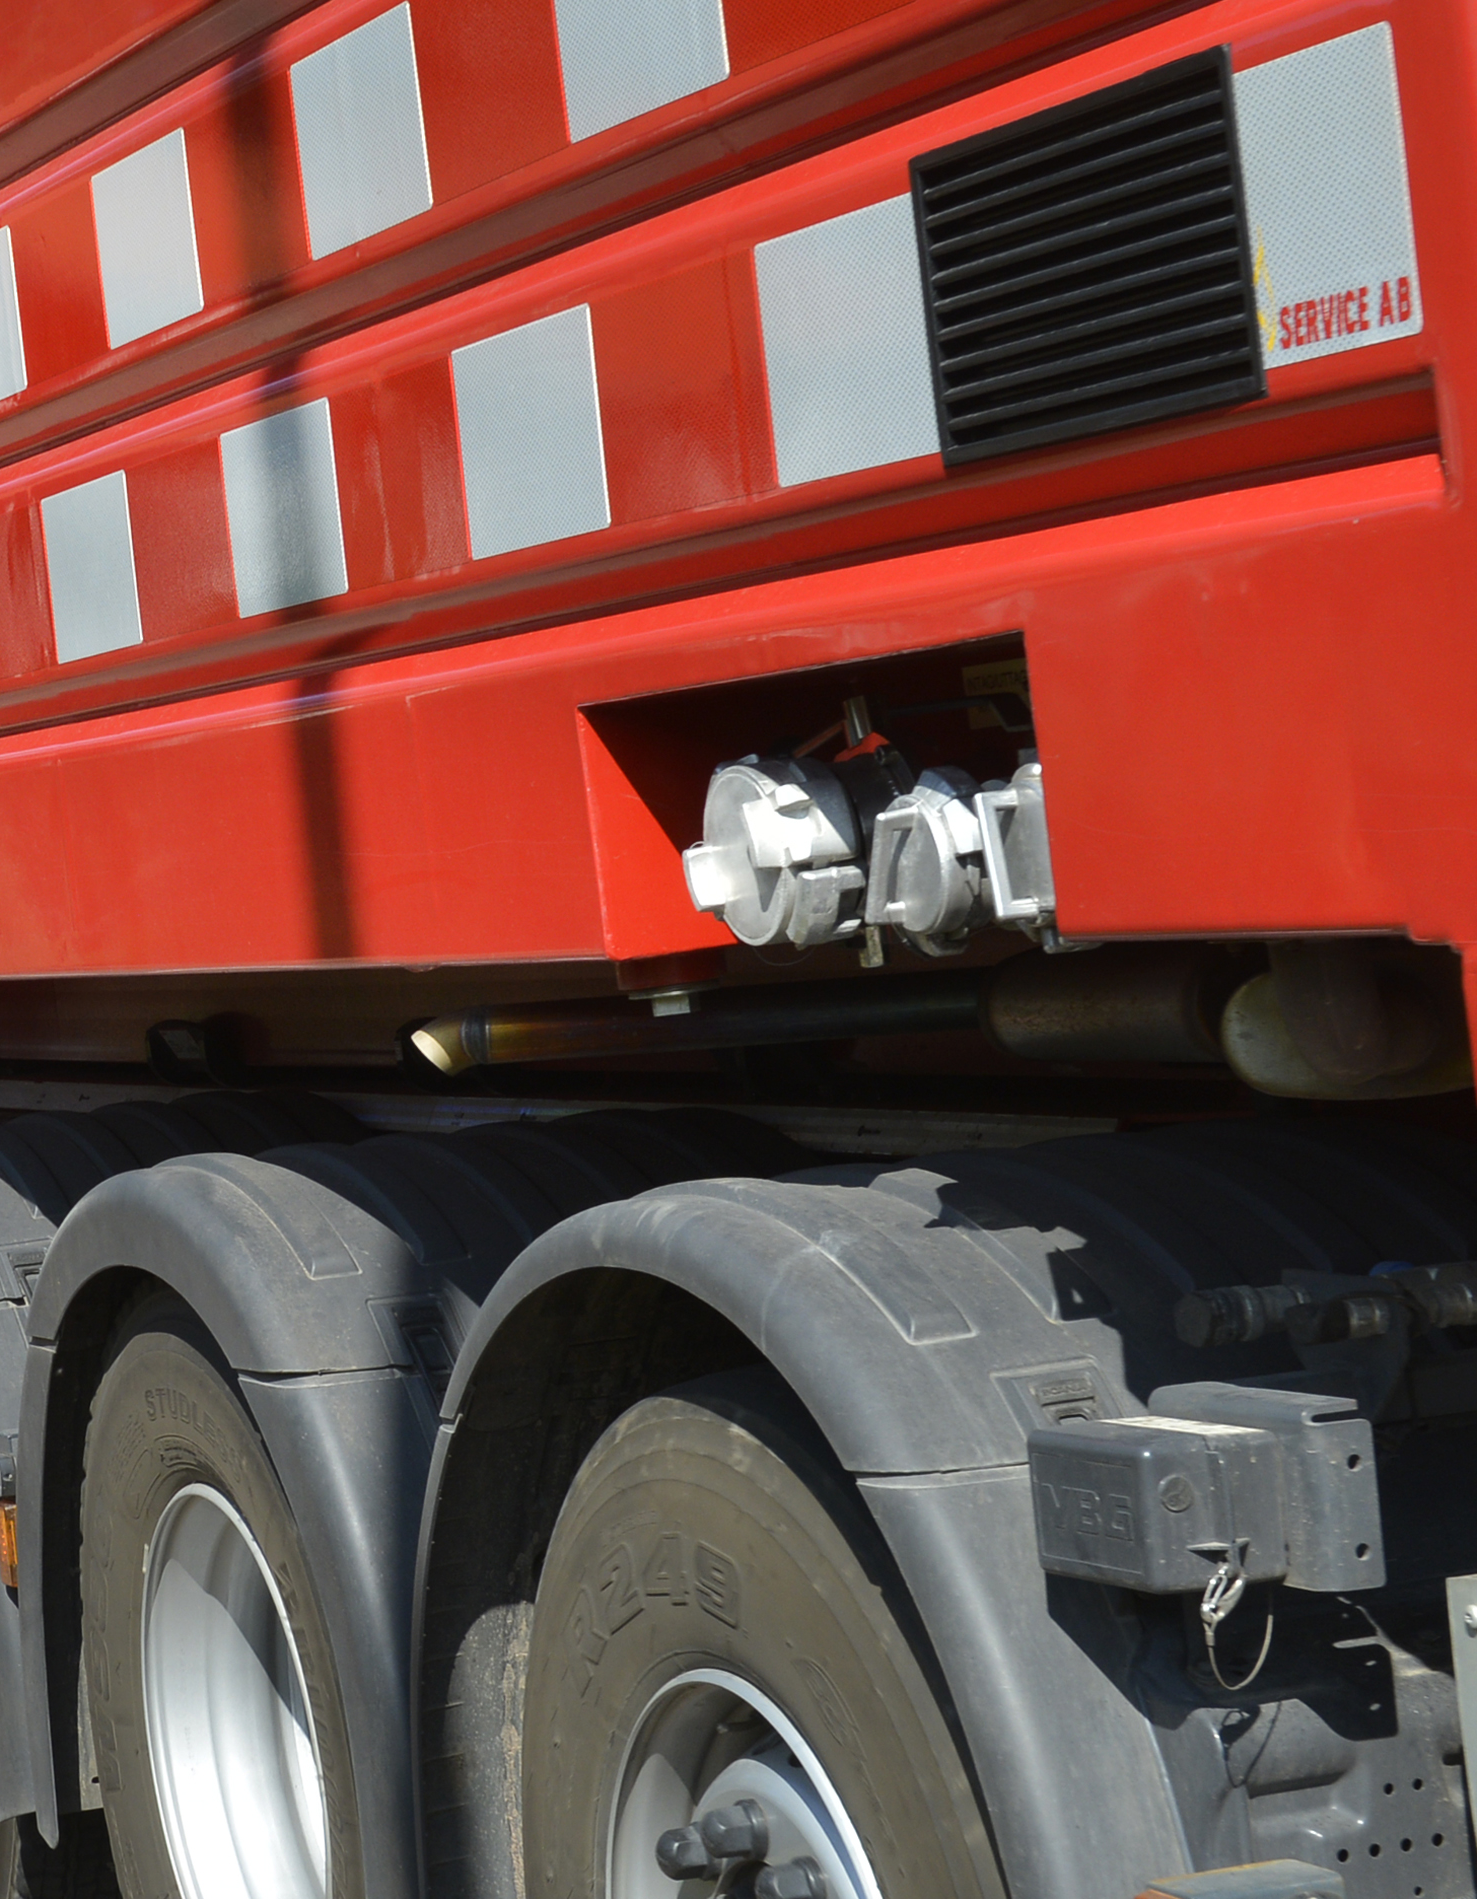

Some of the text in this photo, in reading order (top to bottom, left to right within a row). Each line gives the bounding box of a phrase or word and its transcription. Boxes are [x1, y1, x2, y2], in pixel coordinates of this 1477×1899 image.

[1280, 276, 1412, 350] SERVICE AB
[561, 1530, 742, 1698] R249
